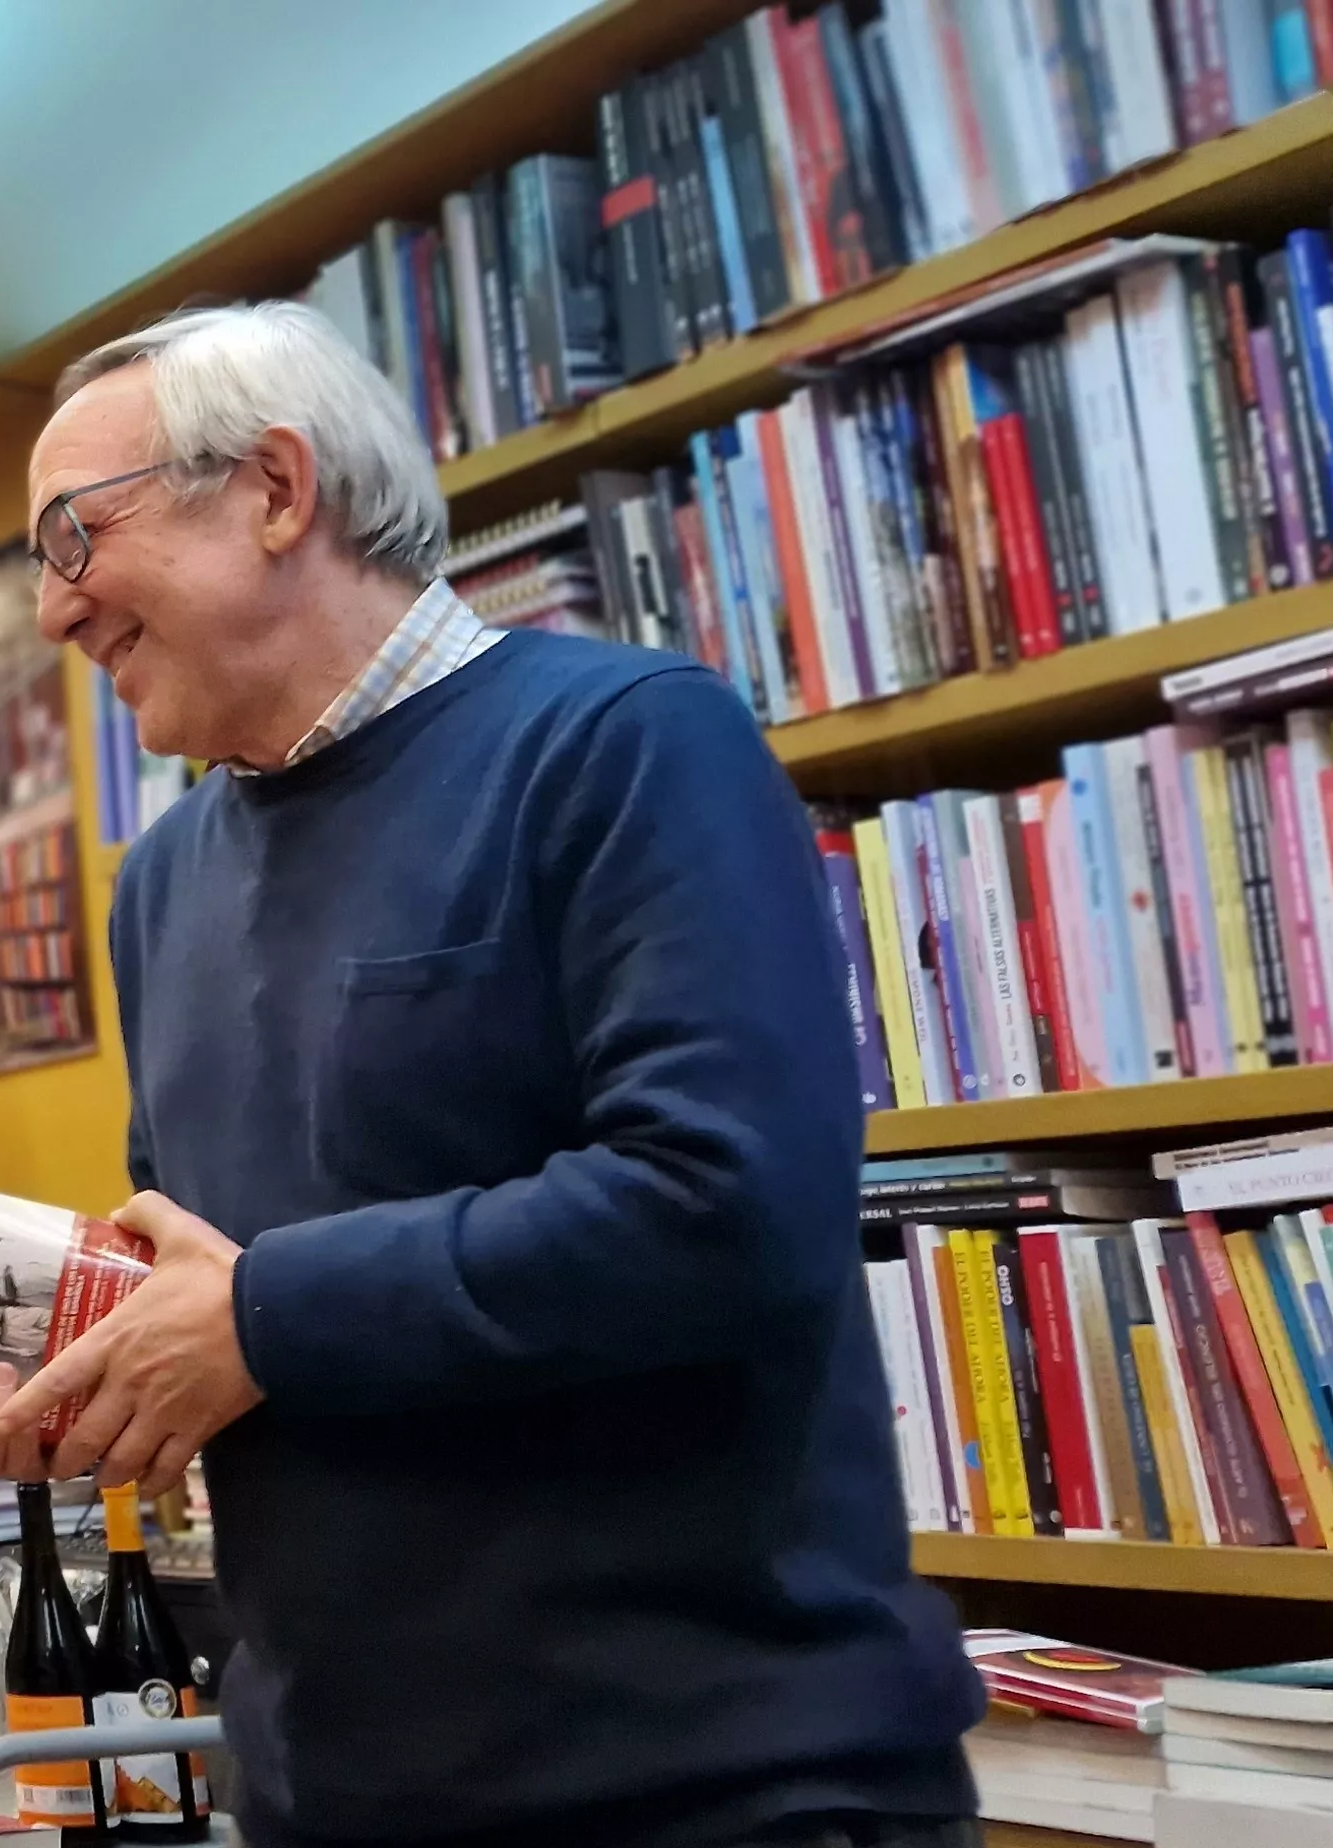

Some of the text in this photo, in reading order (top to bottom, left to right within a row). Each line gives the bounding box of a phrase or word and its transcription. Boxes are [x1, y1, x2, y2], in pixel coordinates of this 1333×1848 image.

[984, 888, 1003, 949] ALTERNATIVAS
[992, 950, 1008, 982] FALSAS
[910, 967, 923, 1015] SIMONE
[996, 983, 1012, 1000] LAS
[998, 1264, 1014, 1306] OSHO
